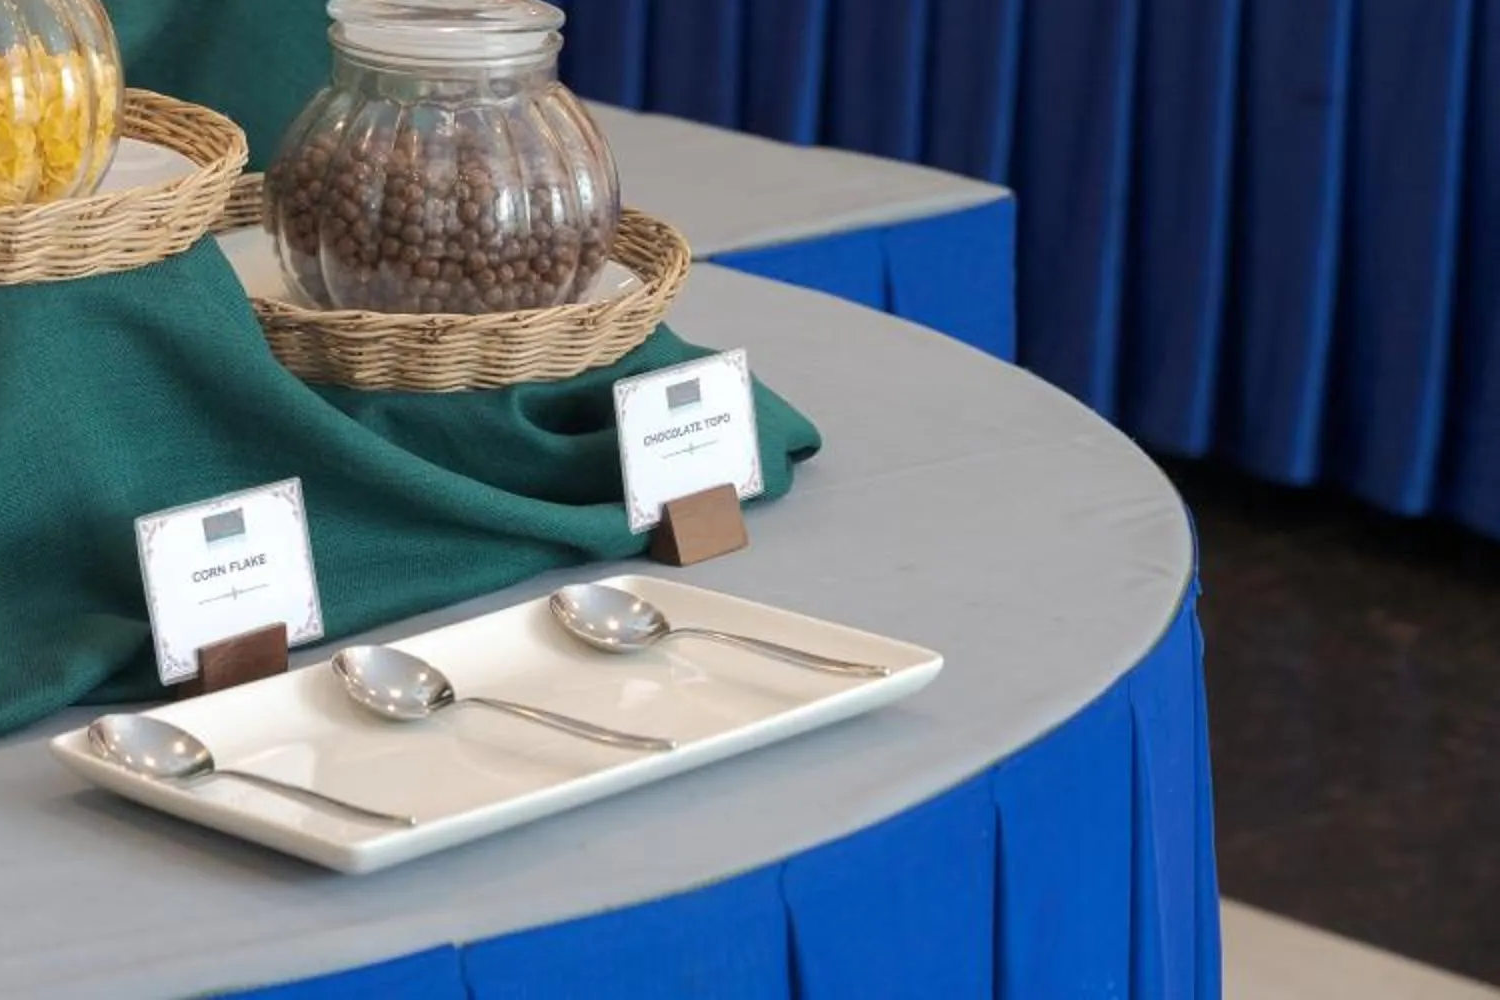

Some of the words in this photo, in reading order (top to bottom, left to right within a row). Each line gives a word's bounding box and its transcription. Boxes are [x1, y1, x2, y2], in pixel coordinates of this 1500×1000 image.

[643, 421, 703, 447] CHOCOLATE
[192, 565, 226, 583] CORN
[229, 553, 268, 573] FLAKE
